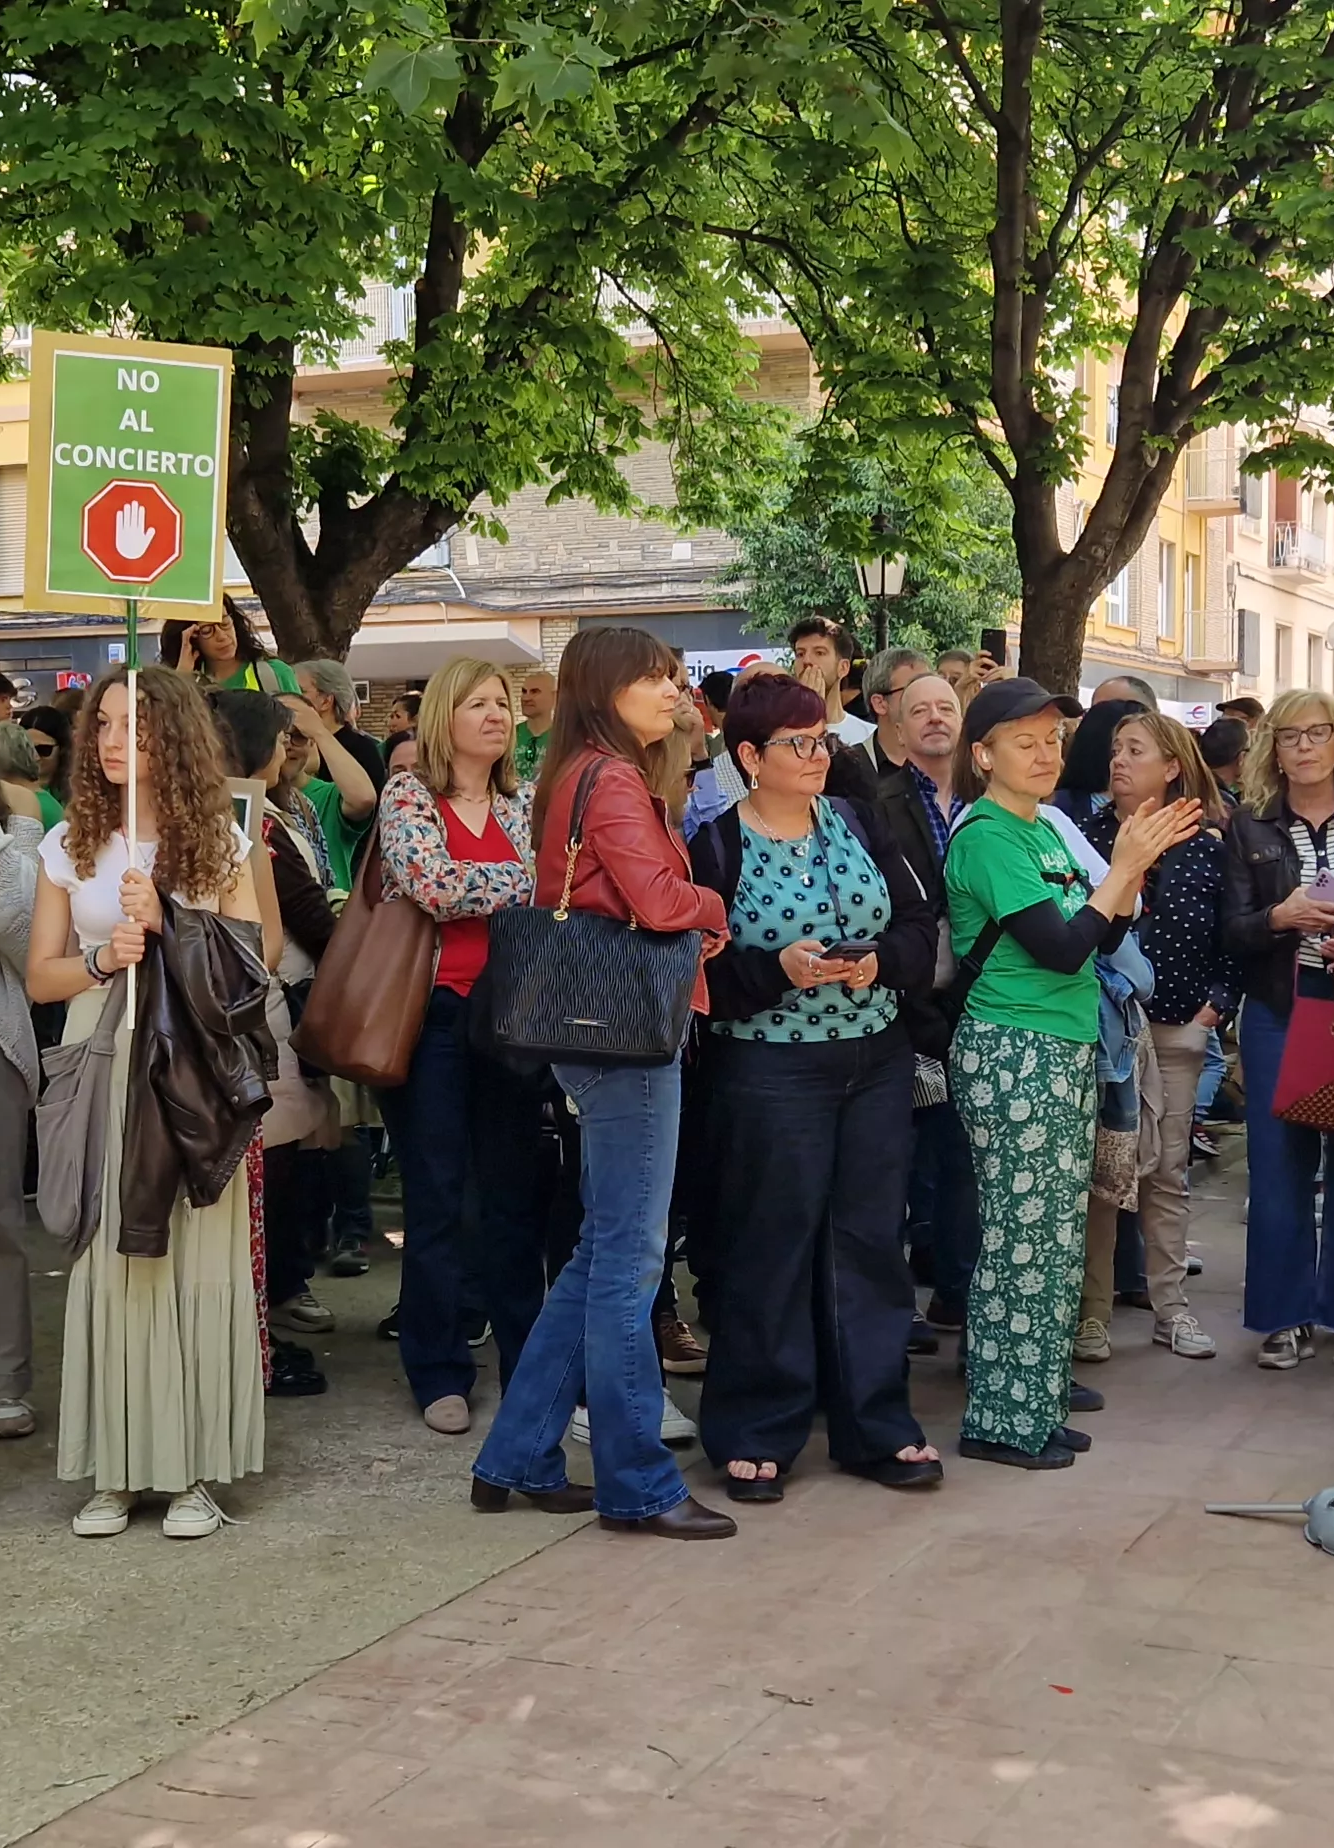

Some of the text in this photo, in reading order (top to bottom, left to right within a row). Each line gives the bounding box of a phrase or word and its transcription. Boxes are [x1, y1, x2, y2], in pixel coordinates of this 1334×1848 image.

[117, 368, 160, 393] NO
[119, 408, 154, 432] AL
[54, 443, 215, 477] CONCIERTO
